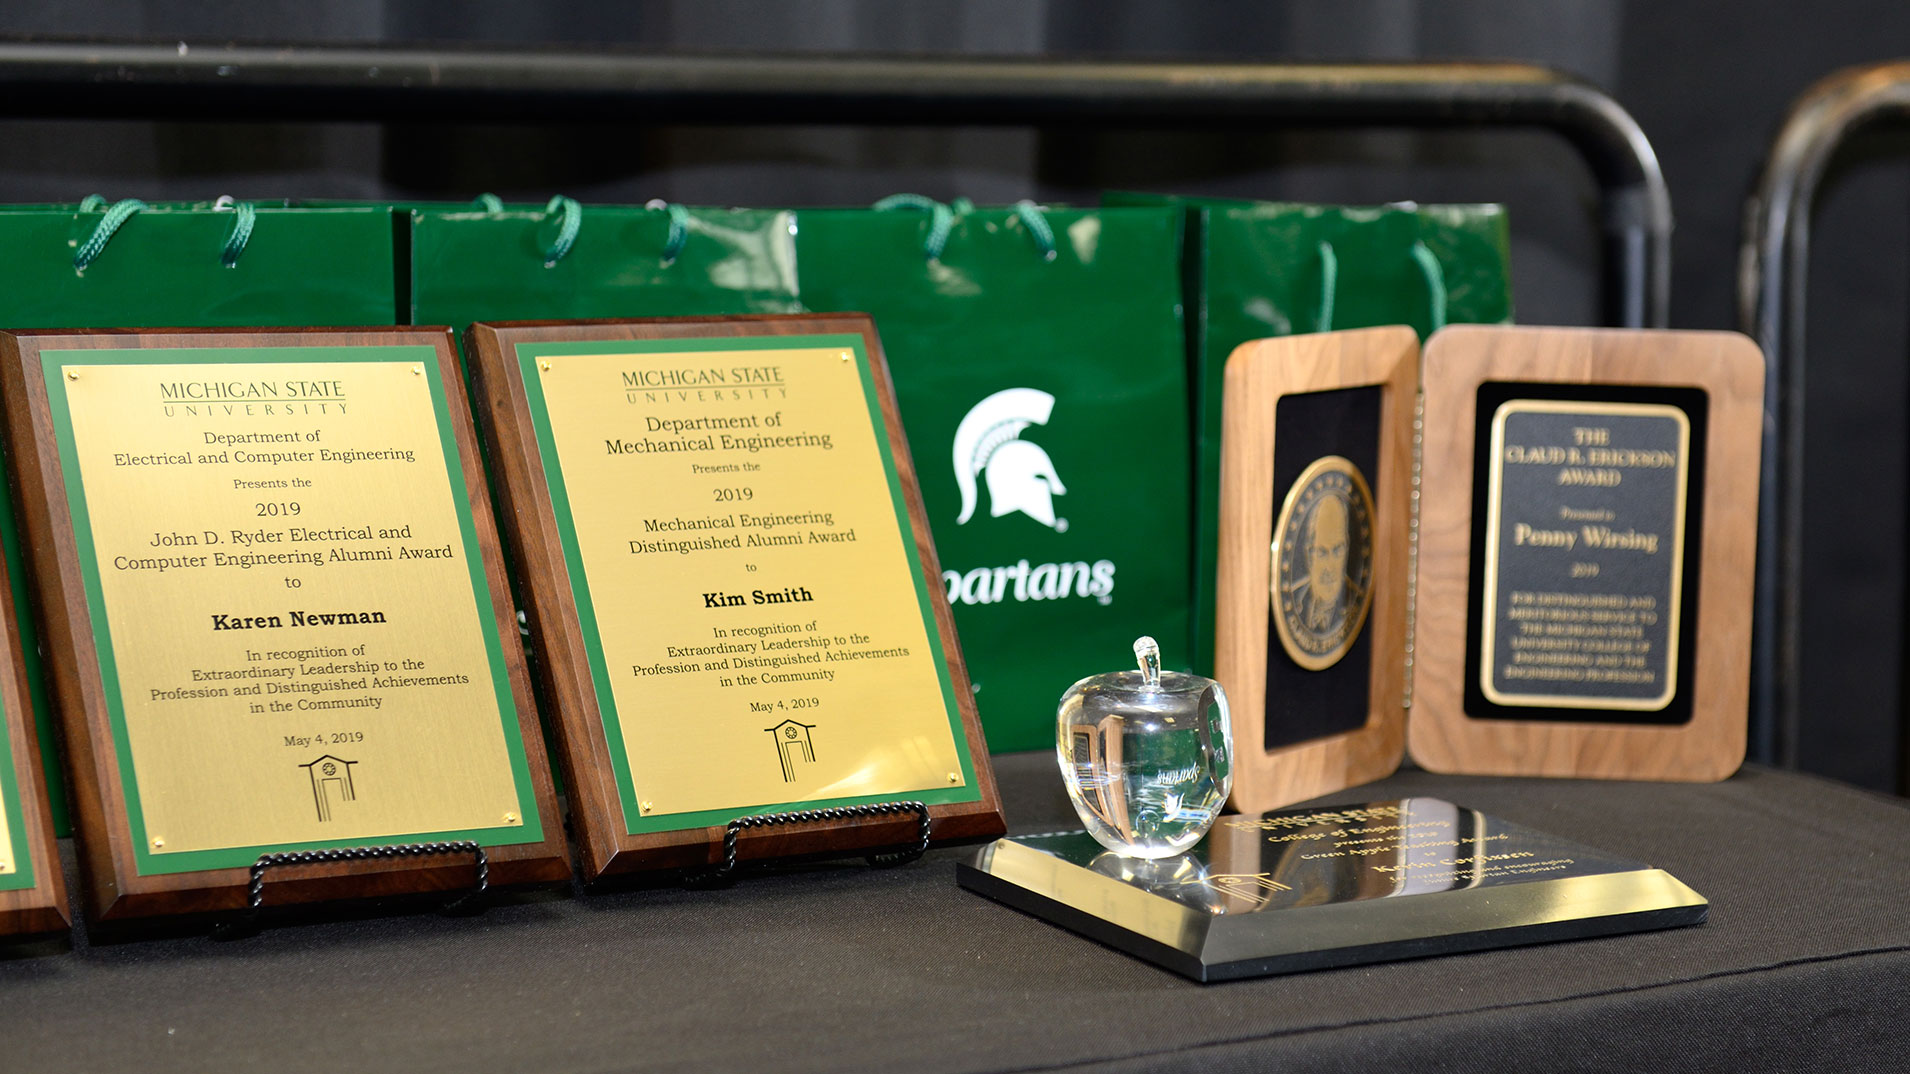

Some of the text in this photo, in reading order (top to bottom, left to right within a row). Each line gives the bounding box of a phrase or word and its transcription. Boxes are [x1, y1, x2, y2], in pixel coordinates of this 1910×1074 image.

[622, 367, 784, 386] MICHIGAN STATE
[161, 381, 345, 398] MICHIGAN STATE
[627, 389, 787, 404] UNIVERSITY
[164, 403, 346, 417] UNIVERSITY
[645, 411, 781, 436] Department of
[204, 430, 320, 447] Department of
[605, 432, 833, 454] Mechanical Engineering
[1574, 427, 1610, 446] THE
[114, 448, 415, 466] Electrical and Computer Engineering
[1504, 445, 1566, 465] CLAUD
[1588, 447, 1676, 468] ERICKSON
[692, 462, 760, 474] Presents the
[234, 478, 311, 489] Presents the
[1557, 468, 1622, 487] AWARD
[713, 488, 753, 502] 2019
[256, 502, 300, 516] 2019
[644, 511, 834, 532] Mechanical Engineering
[150, 525, 412, 547] John D. Ryder Electrical and
[629, 529, 856, 554] Distinguished Alumni Award
[1514, 523, 1659, 554] Penny Wirsing
[114, 545, 453, 572] Computer Engineering Alumni Award
[746, 564, 757, 572] to
[285, 577, 301, 588] to
[942, 559, 1115, 604] partans
[703, 587, 813, 608] Kim Smith
[211, 611, 386, 630] Karen Newman
[713, 620, 816, 638] In recognition of
[246, 644, 365, 662] In recognition of
[667, 633, 870, 658] Extraordinary Leadership to the
[192, 659, 424, 681] Extraordinary Leadership to the
[633, 648, 909, 676] Profession and Distinguished Achievements
[720, 669, 834, 687] in the Community
[150, 674, 469, 701] Profession and Distinguished Achievements
[249, 696, 382, 713] in the Community
[750, 697, 819, 713] May 4, 2019
[284, 732, 363, 748] May 4, 2019
[1268, 832, 1326, 842] College
[1301, 850, 1345, 860] Green
